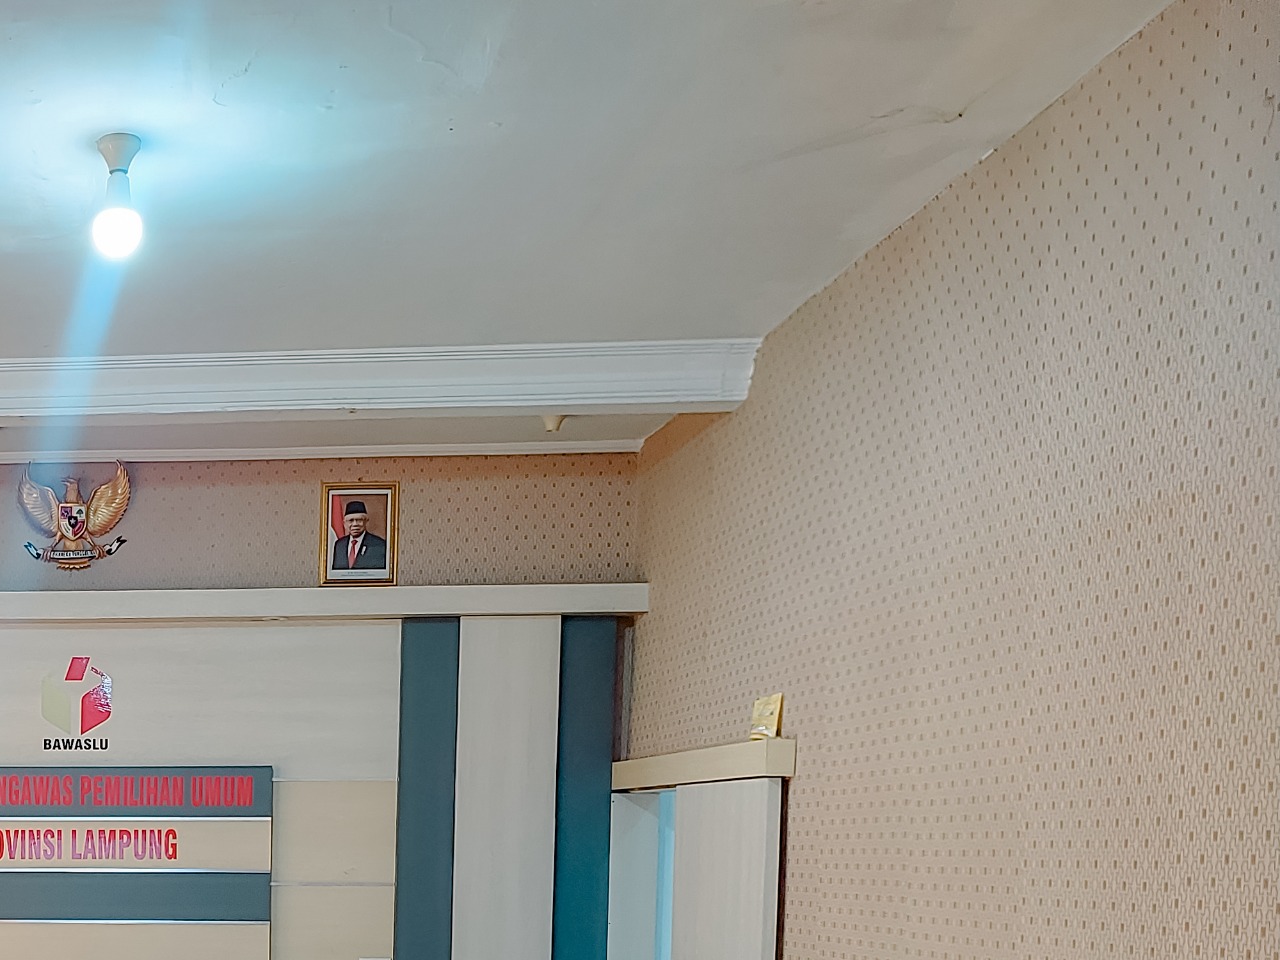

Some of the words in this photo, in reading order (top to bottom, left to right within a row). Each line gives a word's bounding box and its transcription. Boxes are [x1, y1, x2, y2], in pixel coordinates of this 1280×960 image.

[43, 738, 109, 751] BAWASLU
[80, 775, 184, 807] PEMILIHAN
[191, 776, 254, 807] UMUM
[71, 829, 178, 860] LAMPUNG
